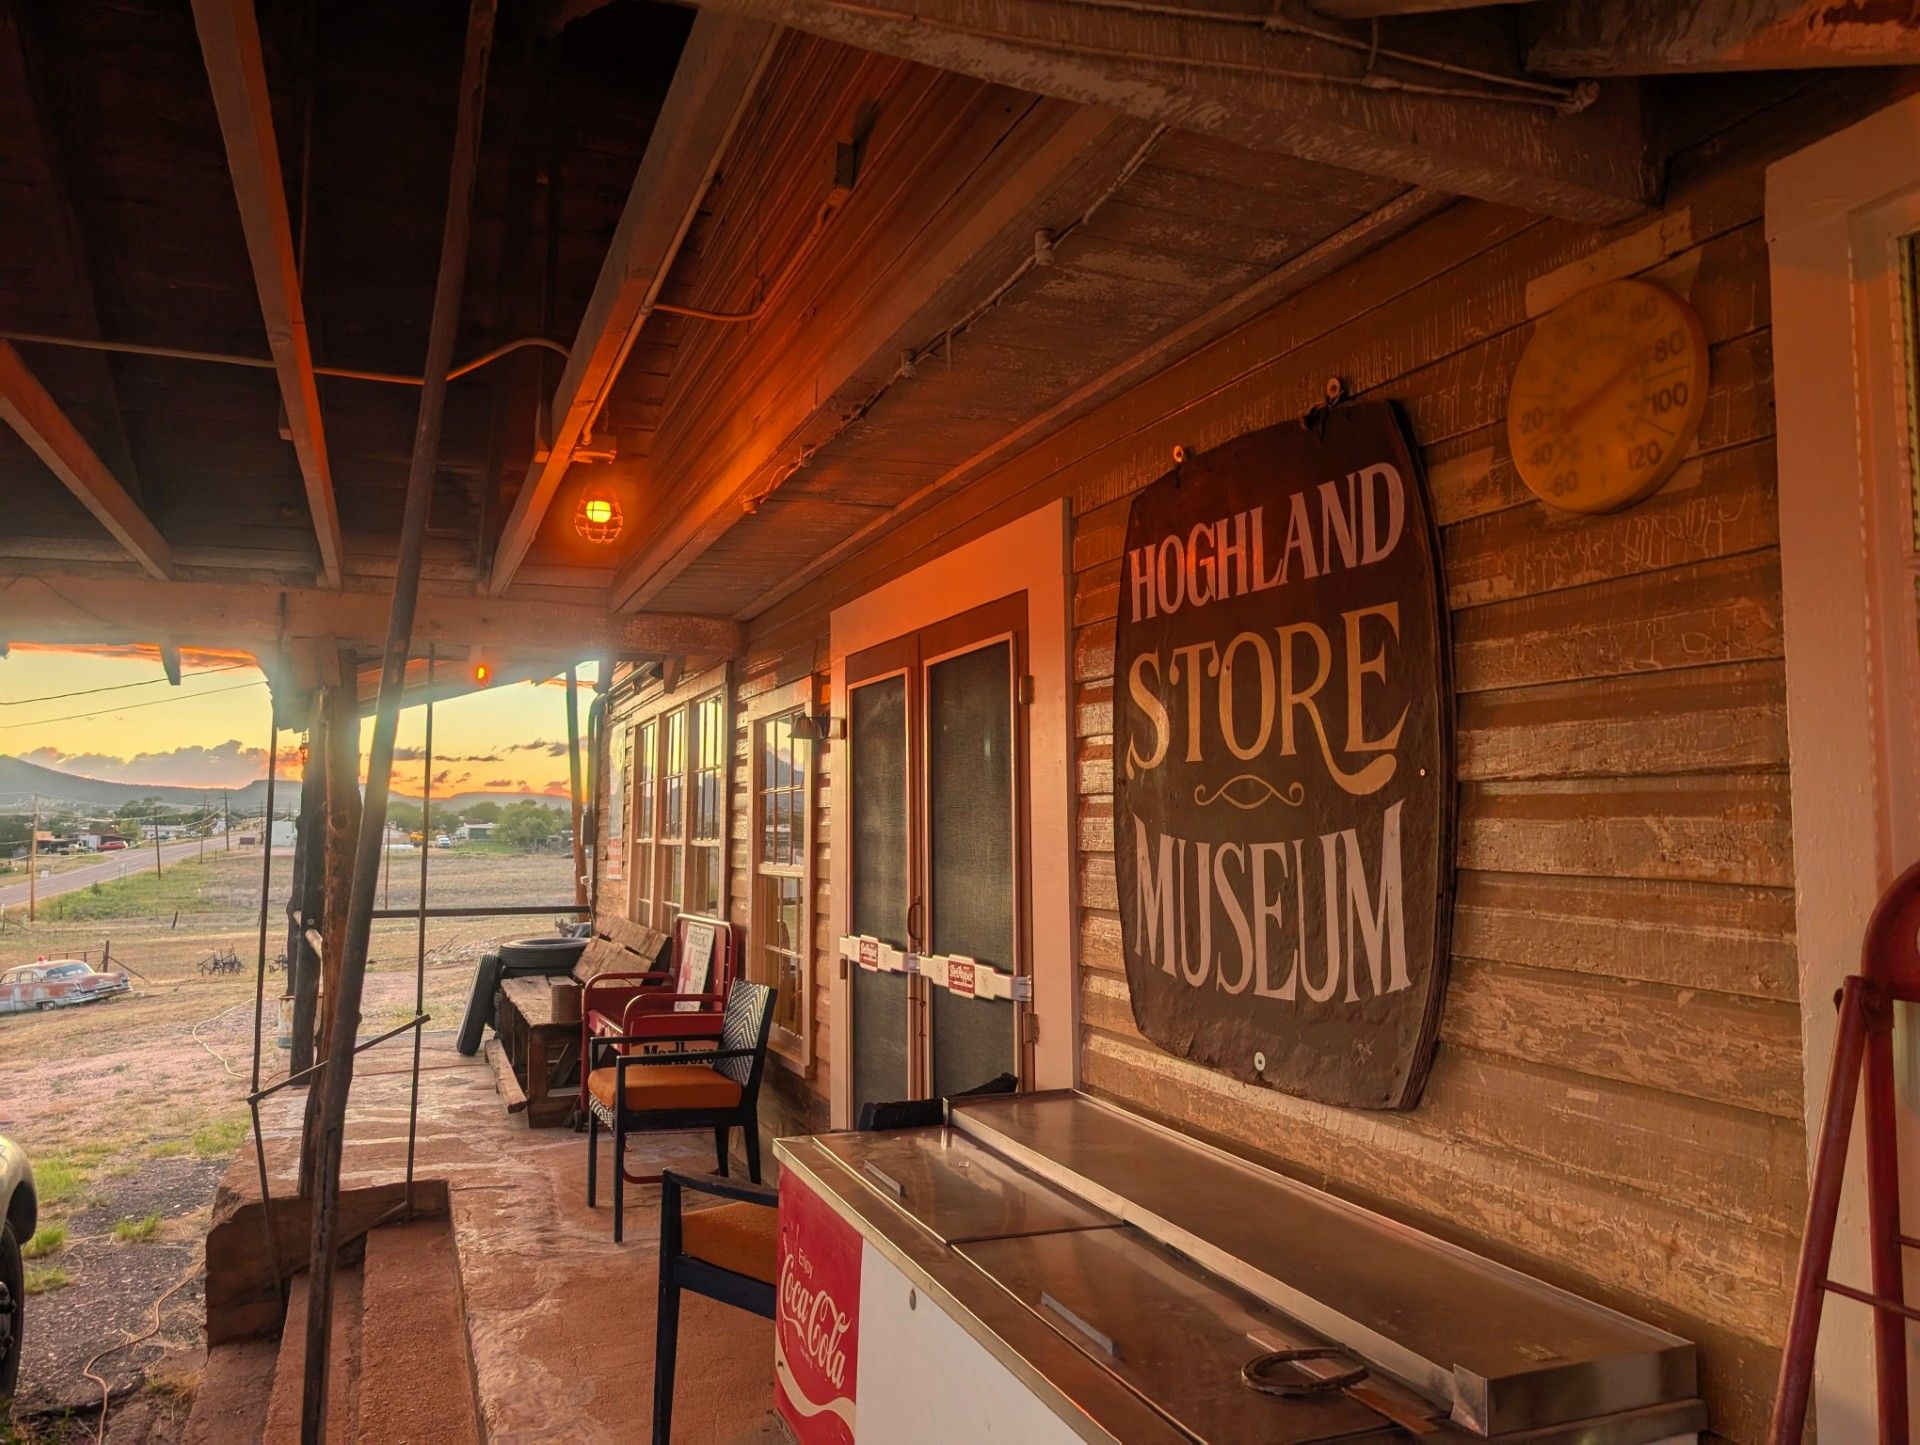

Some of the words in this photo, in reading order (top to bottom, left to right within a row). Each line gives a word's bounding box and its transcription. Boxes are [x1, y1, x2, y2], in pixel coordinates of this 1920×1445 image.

[1651, 380, 1689, 416] 100
[1653, 329, 1686, 364] 80
[1627, 439, 1662, 471] 120
[1128, 462, 1405, 624] HOGHLAND
[1126, 601, 1411, 796] STORE
[1128, 799, 1412, 1003] MUSEUM
[780, 1253, 852, 1390] Coca-Cola
